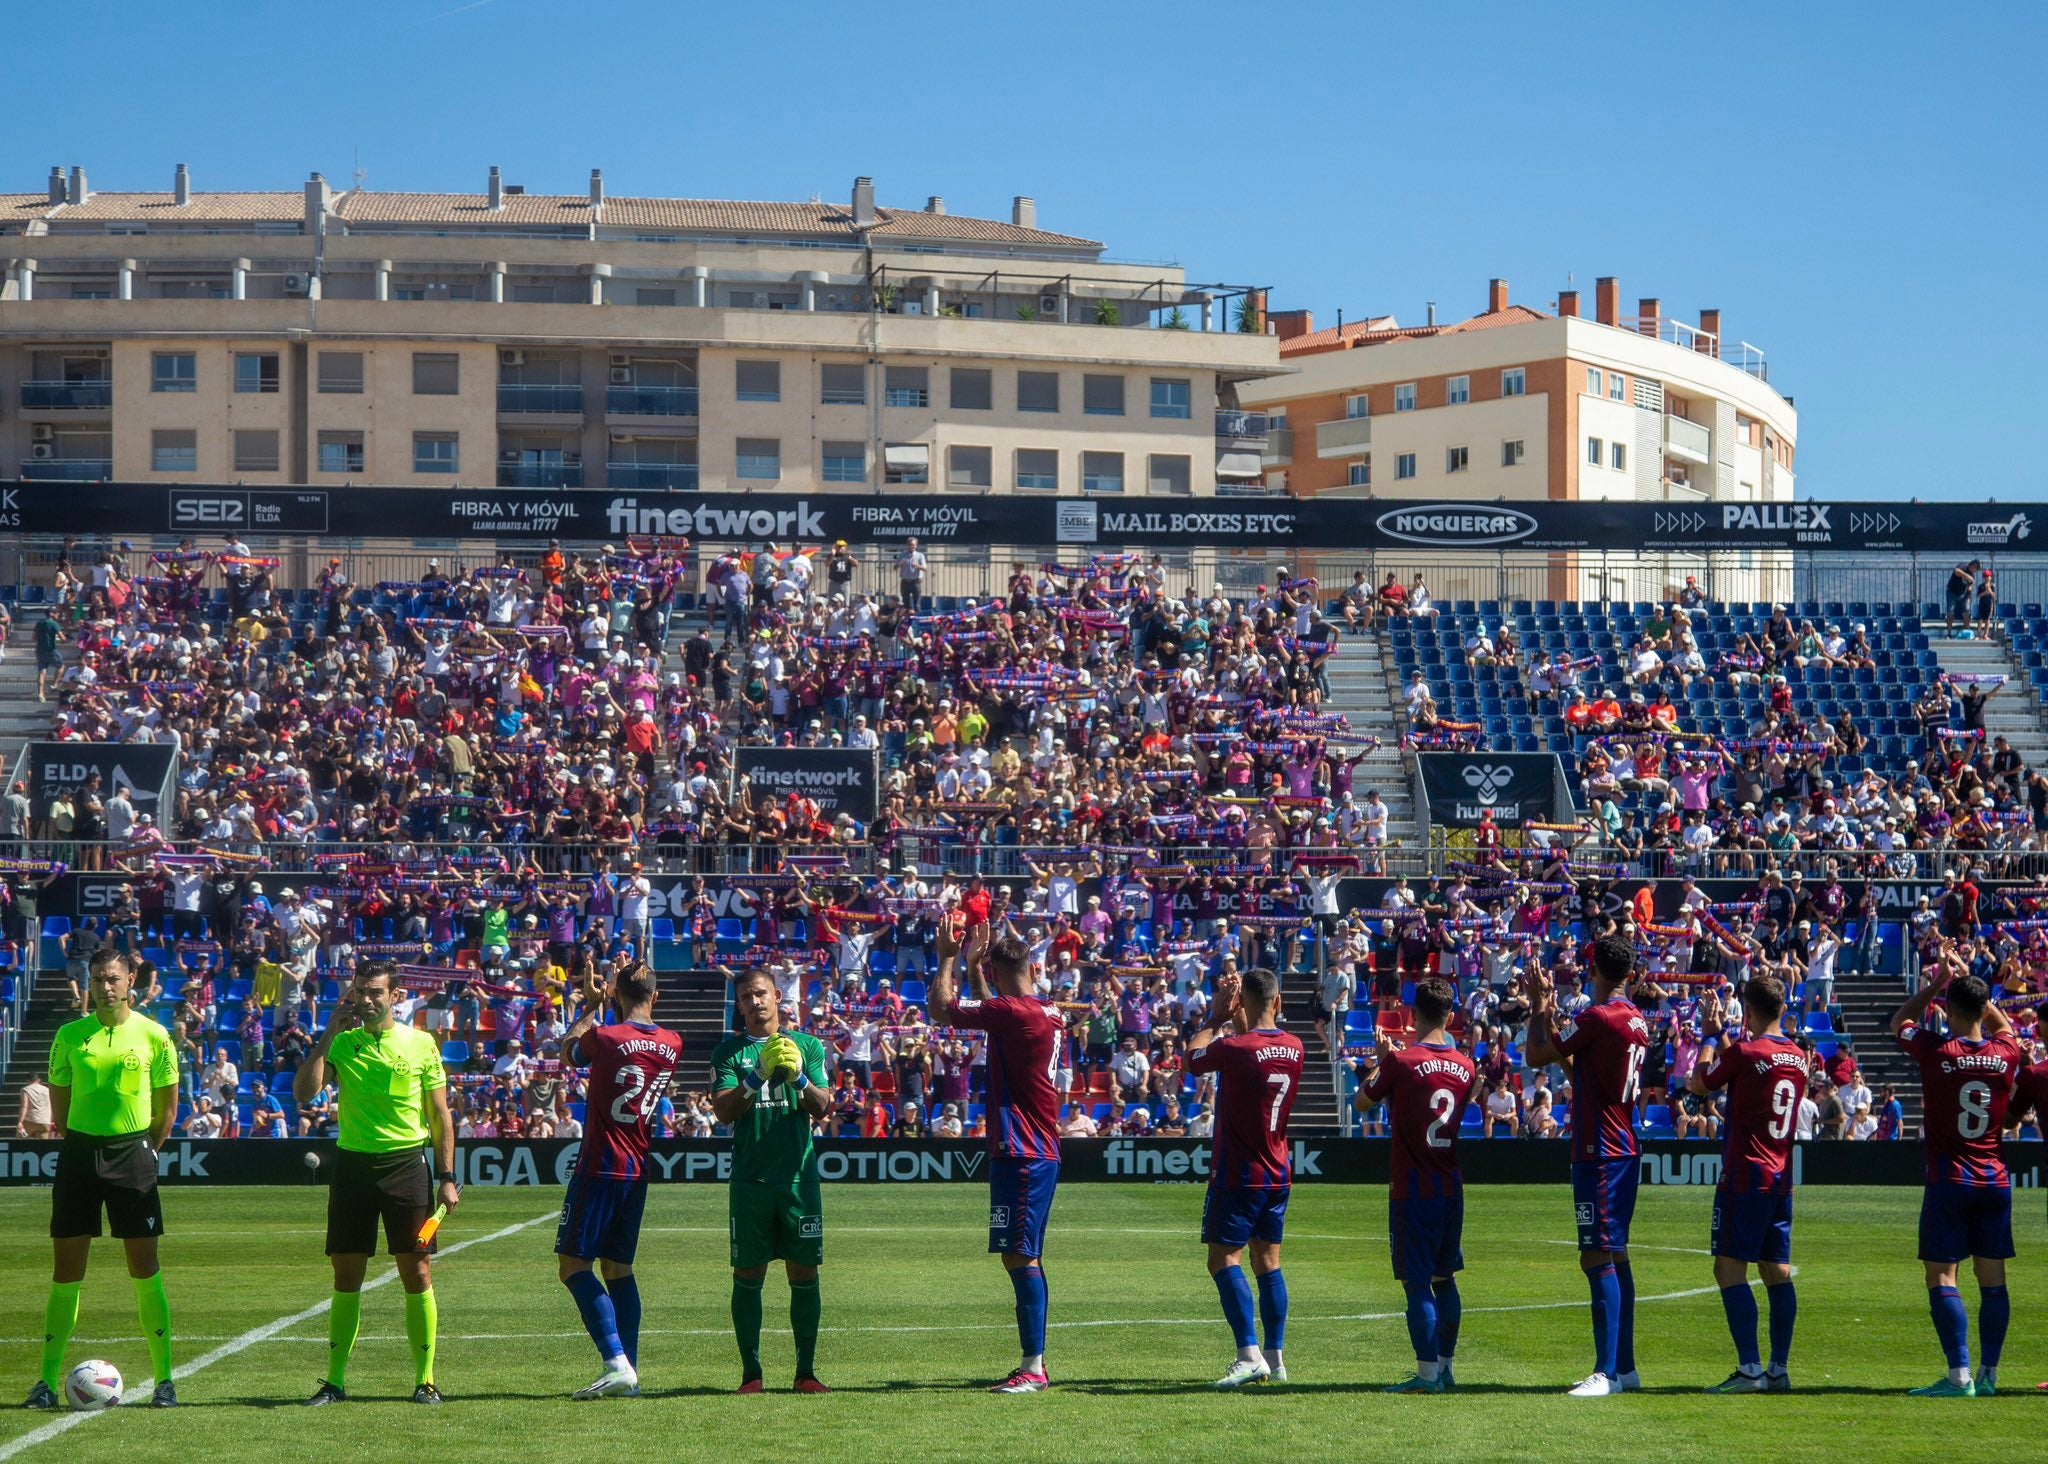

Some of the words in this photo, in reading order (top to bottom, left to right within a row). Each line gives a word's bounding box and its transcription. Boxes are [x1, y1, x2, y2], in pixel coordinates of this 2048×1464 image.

[255, 504, 281, 514] Radio
[255, 512, 280, 522] ELDA
[451, 502, 503, 516] FIBRA
[507, 502, 520, 516] Y
[524, 499, 579, 517] MÓVIL
[607, 498, 826, 536] finetwork
[853, 507, 902, 522] FIBRA
[908, 508, 920, 522] Y
[923, 504, 978, 523] MÓVIL
[1723, 505, 1832, 530] PALLEX
[472, 521, 495, 530] LLAMA
[496, 521, 521, 531] GRATIS
[521, 522, 531, 531] AL
[532, 518, 559, 531] 1777
[873, 526, 895, 535] LLAMA
[896, 526, 919, 536] GRATIS
[920, 527, 931, 536] AL
[931, 523, 957, 536] 1777
[1103, 513, 1166, 532] MAIL
[1170, 514, 1242, 533] BOXES
[1396, 515, 1518, 534] NOGUERAS
[1969, 525, 2007, 536] PAASA
[1797, 532, 1832, 543] IBERIA
[750, 766, 861, 786] finetwork
[775, 787, 799, 795] FIBRA
[802, 787, 808, 795] Y
[809, 785, 836, 795] MÓVIL
[817, 798, 837, 809] 1777
[1569, 865, 1617, 875] DEPORTIVO
[327, 888, 361, 896] ELDENSE
[537, 882, 587, 891] DEPORTIVO
[850, 1005, 883, 1013] ELDENSE
[617, 1039, 657, 1056] TIMOR
[1941, 1060, 1956, 1073] S.
[1957, 1054, 2008, 1074] ORTUÑO
[611, 1065, 673, 1124] 24
[1267, 1073, 1291, 1132] 7
[1427, 1088, 1455, 1148] 2
[1768, 1079, 1796, 1139] 9
[1957, 1080, 1992, 1139] 8
[0, 1142, 209, 1177] inerk
[1103, 1141, 1323, 1175] finetk
[1641, 1145, 1802, 1185] huml
